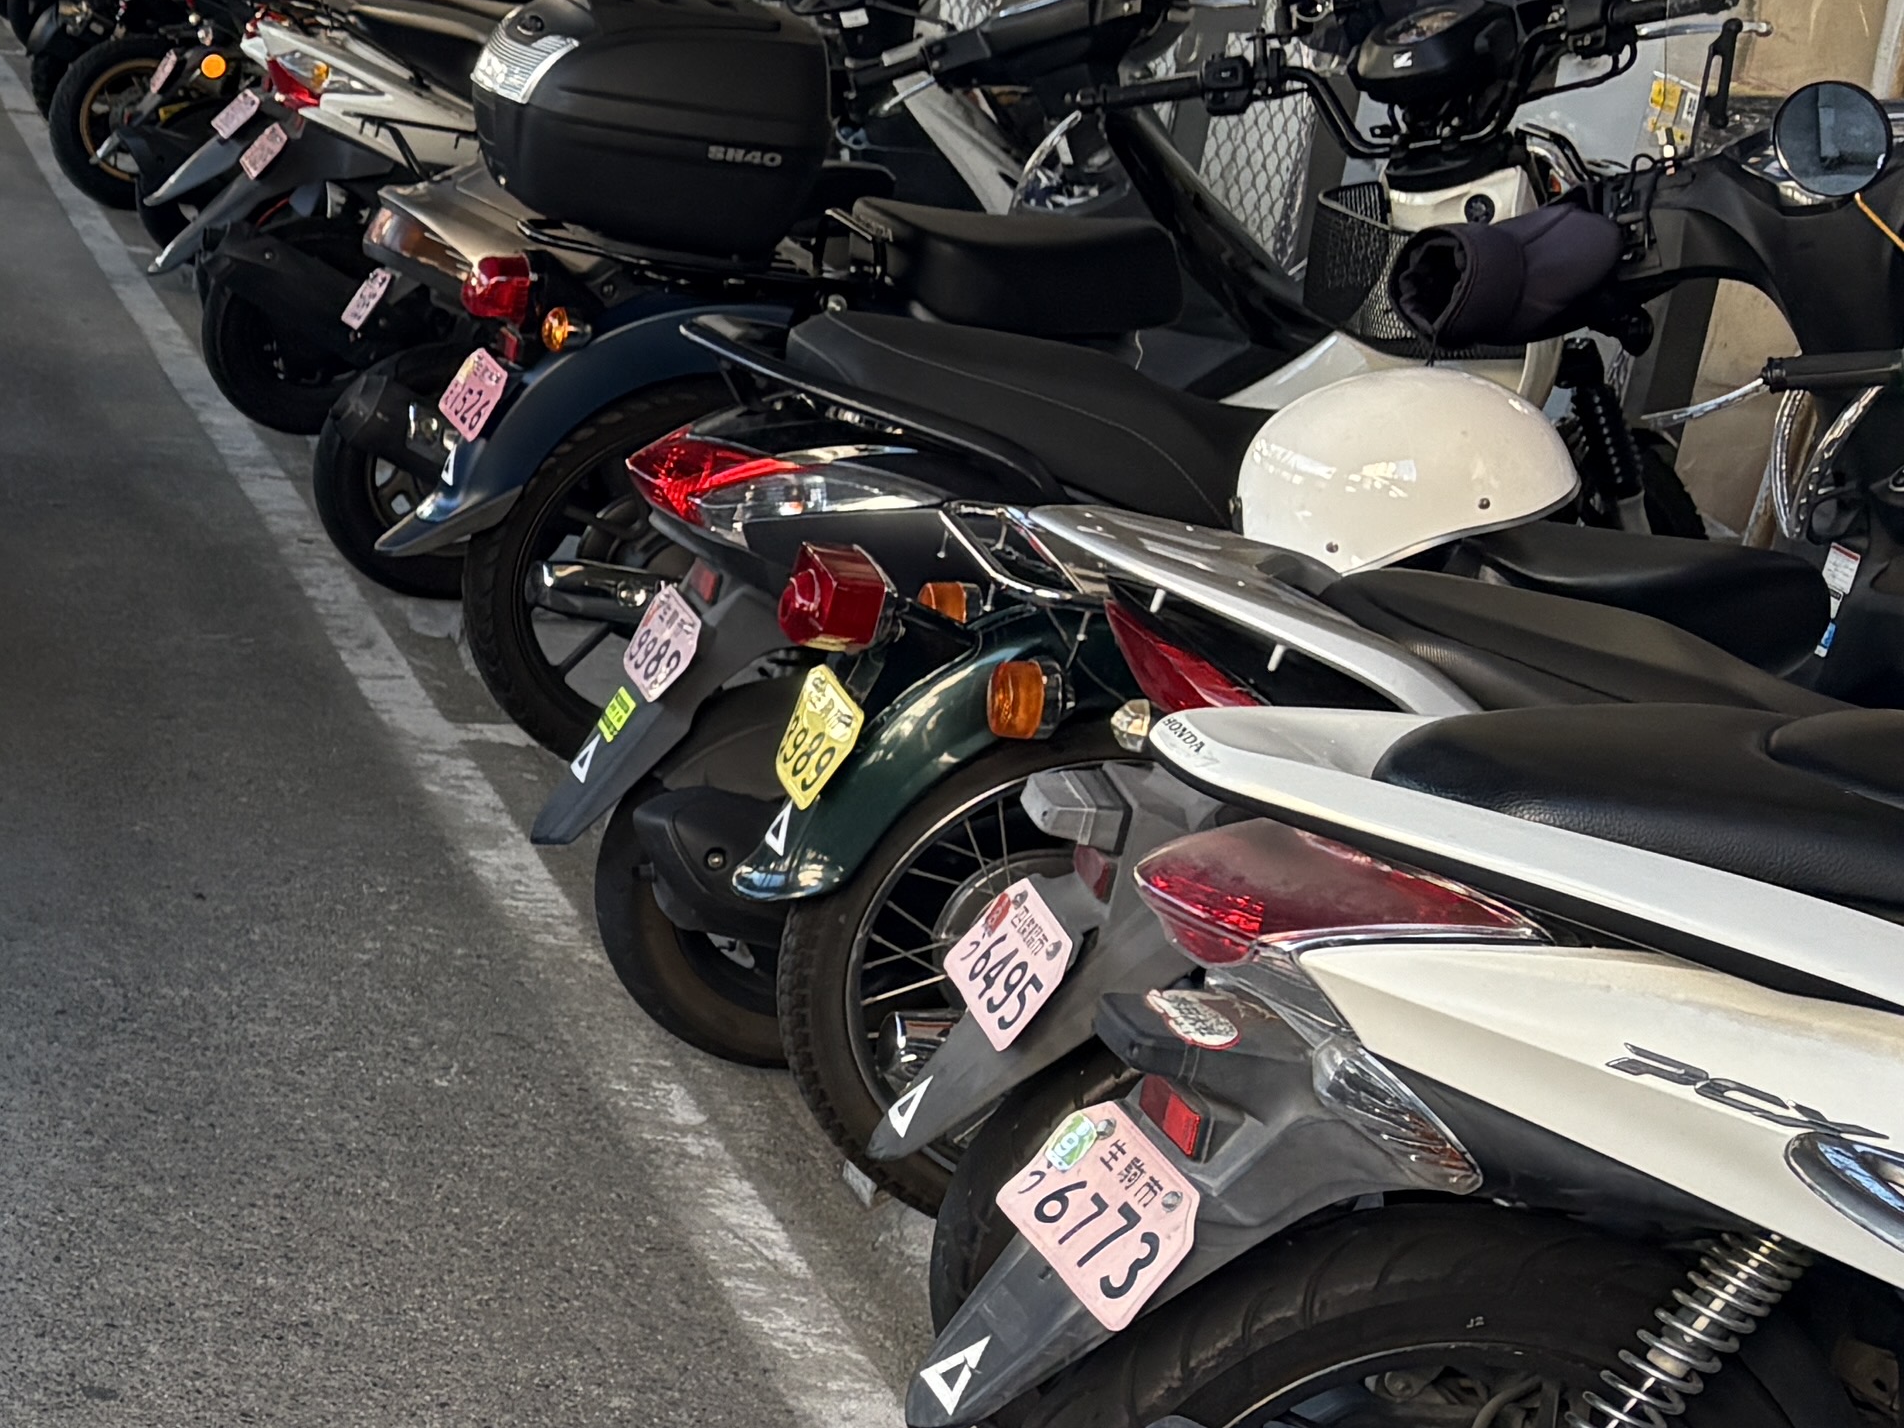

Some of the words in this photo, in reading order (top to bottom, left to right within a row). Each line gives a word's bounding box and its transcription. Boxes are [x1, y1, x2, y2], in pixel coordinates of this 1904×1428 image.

[707, 144, 783, 168] SH40
[1162, 716, 1206, 754] HONDA
[968, 932, 1045, 1031] 6495
[1604, 1041, 1891, 1141] PCX
[1100, 1139, 1164, 1209] 生駒市
[1033, 1179, 1161, 1300] 6773
